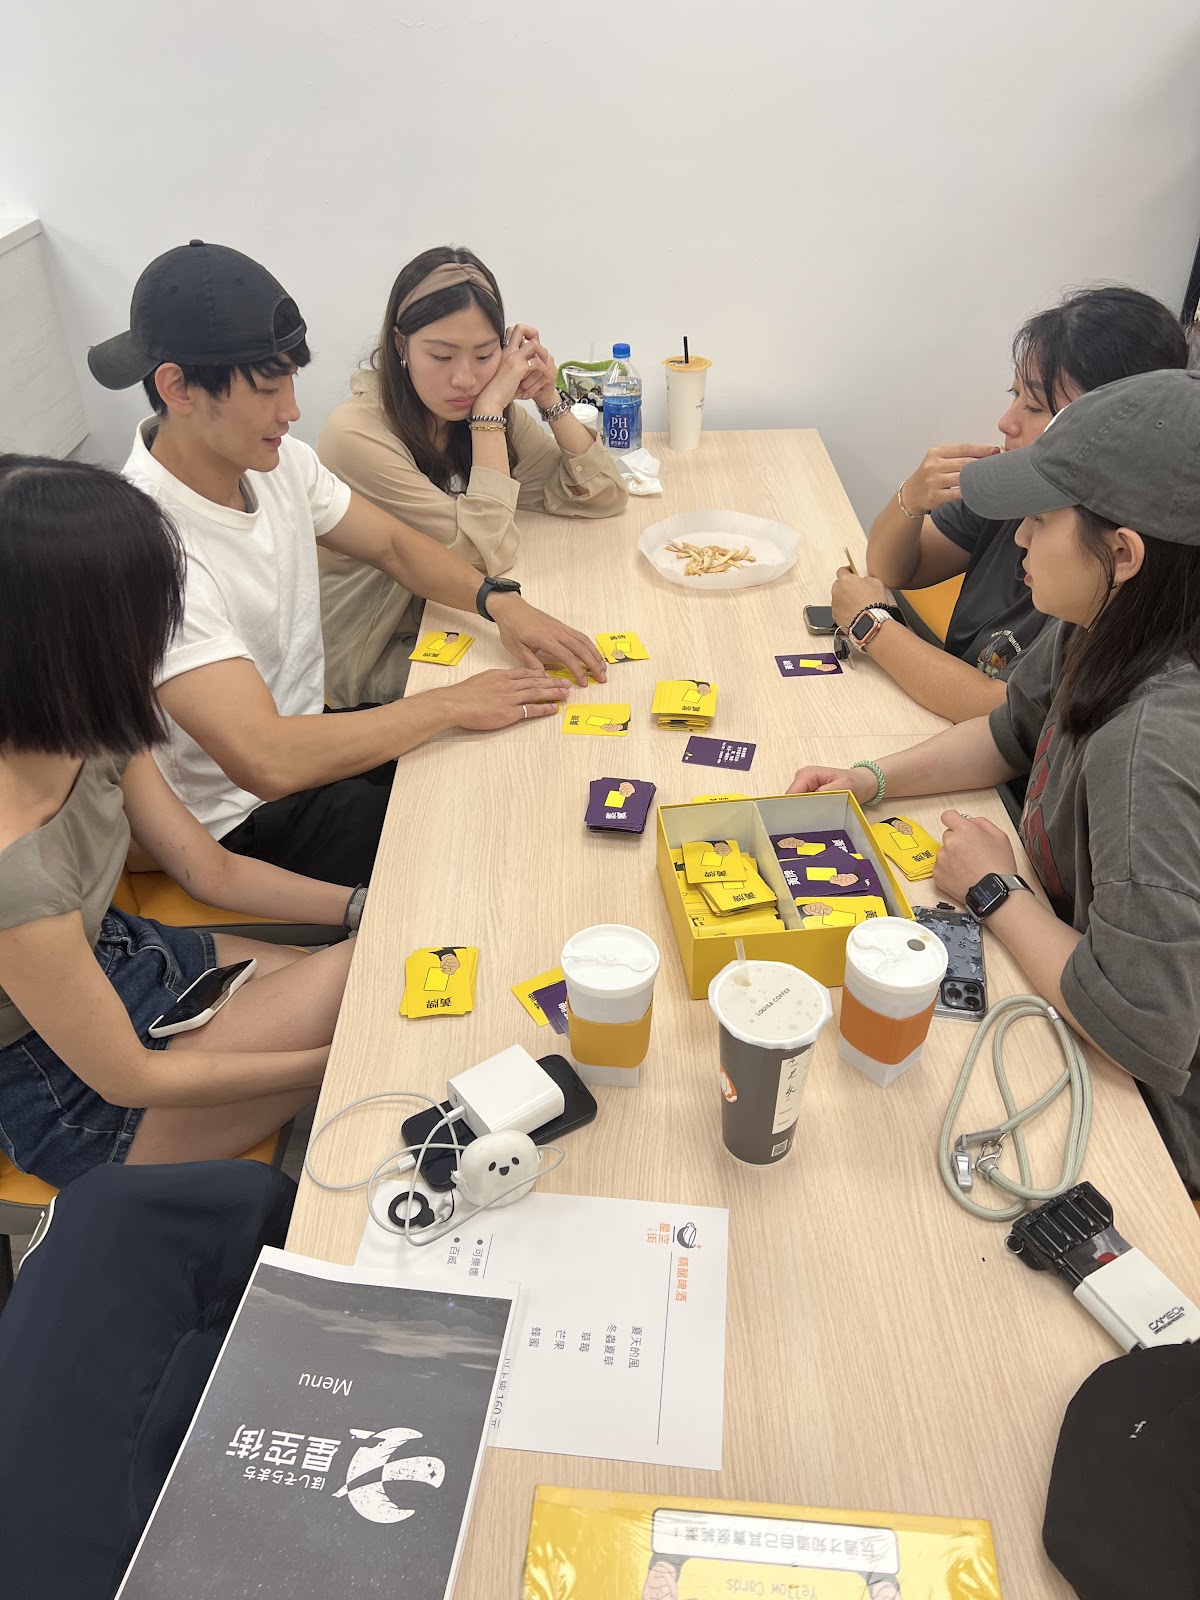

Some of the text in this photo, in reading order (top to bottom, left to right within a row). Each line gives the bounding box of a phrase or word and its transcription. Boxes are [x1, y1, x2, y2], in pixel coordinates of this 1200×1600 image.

[611, 417, 627, 428] PH
[610, 429, 629, 441] 9.0
[912, 850, 934, 862] 黃牌
[783, 869, 801, 886] 黃牌
[426, 997, 452, 1009] 黃牌
[755, 987, 791, 1017] LOUISA COFFEE
[447, 1246, 461, 1265] 百威
[468, 1248, 484, 1277] 可樂娜
[675, 1257, 689, 1303] 精釀啤酒
[528, 1326, 542, 1348] 蜂蜜
[554, 1329, 567, 1350] 芒果
[579, 1331, 591, 1353] 草莓
[603, 1323, 617, 1367] 冬蟲夏草
[628, 1326, 643, 1369] 夏天的風
[298, 1373, 353, 1396] Menu
[225, 1424, 342, 1472] 星空街
[243, 1466, 326, 1491] ほしそらまち
[726, 1578, 764, 1596] Cards
